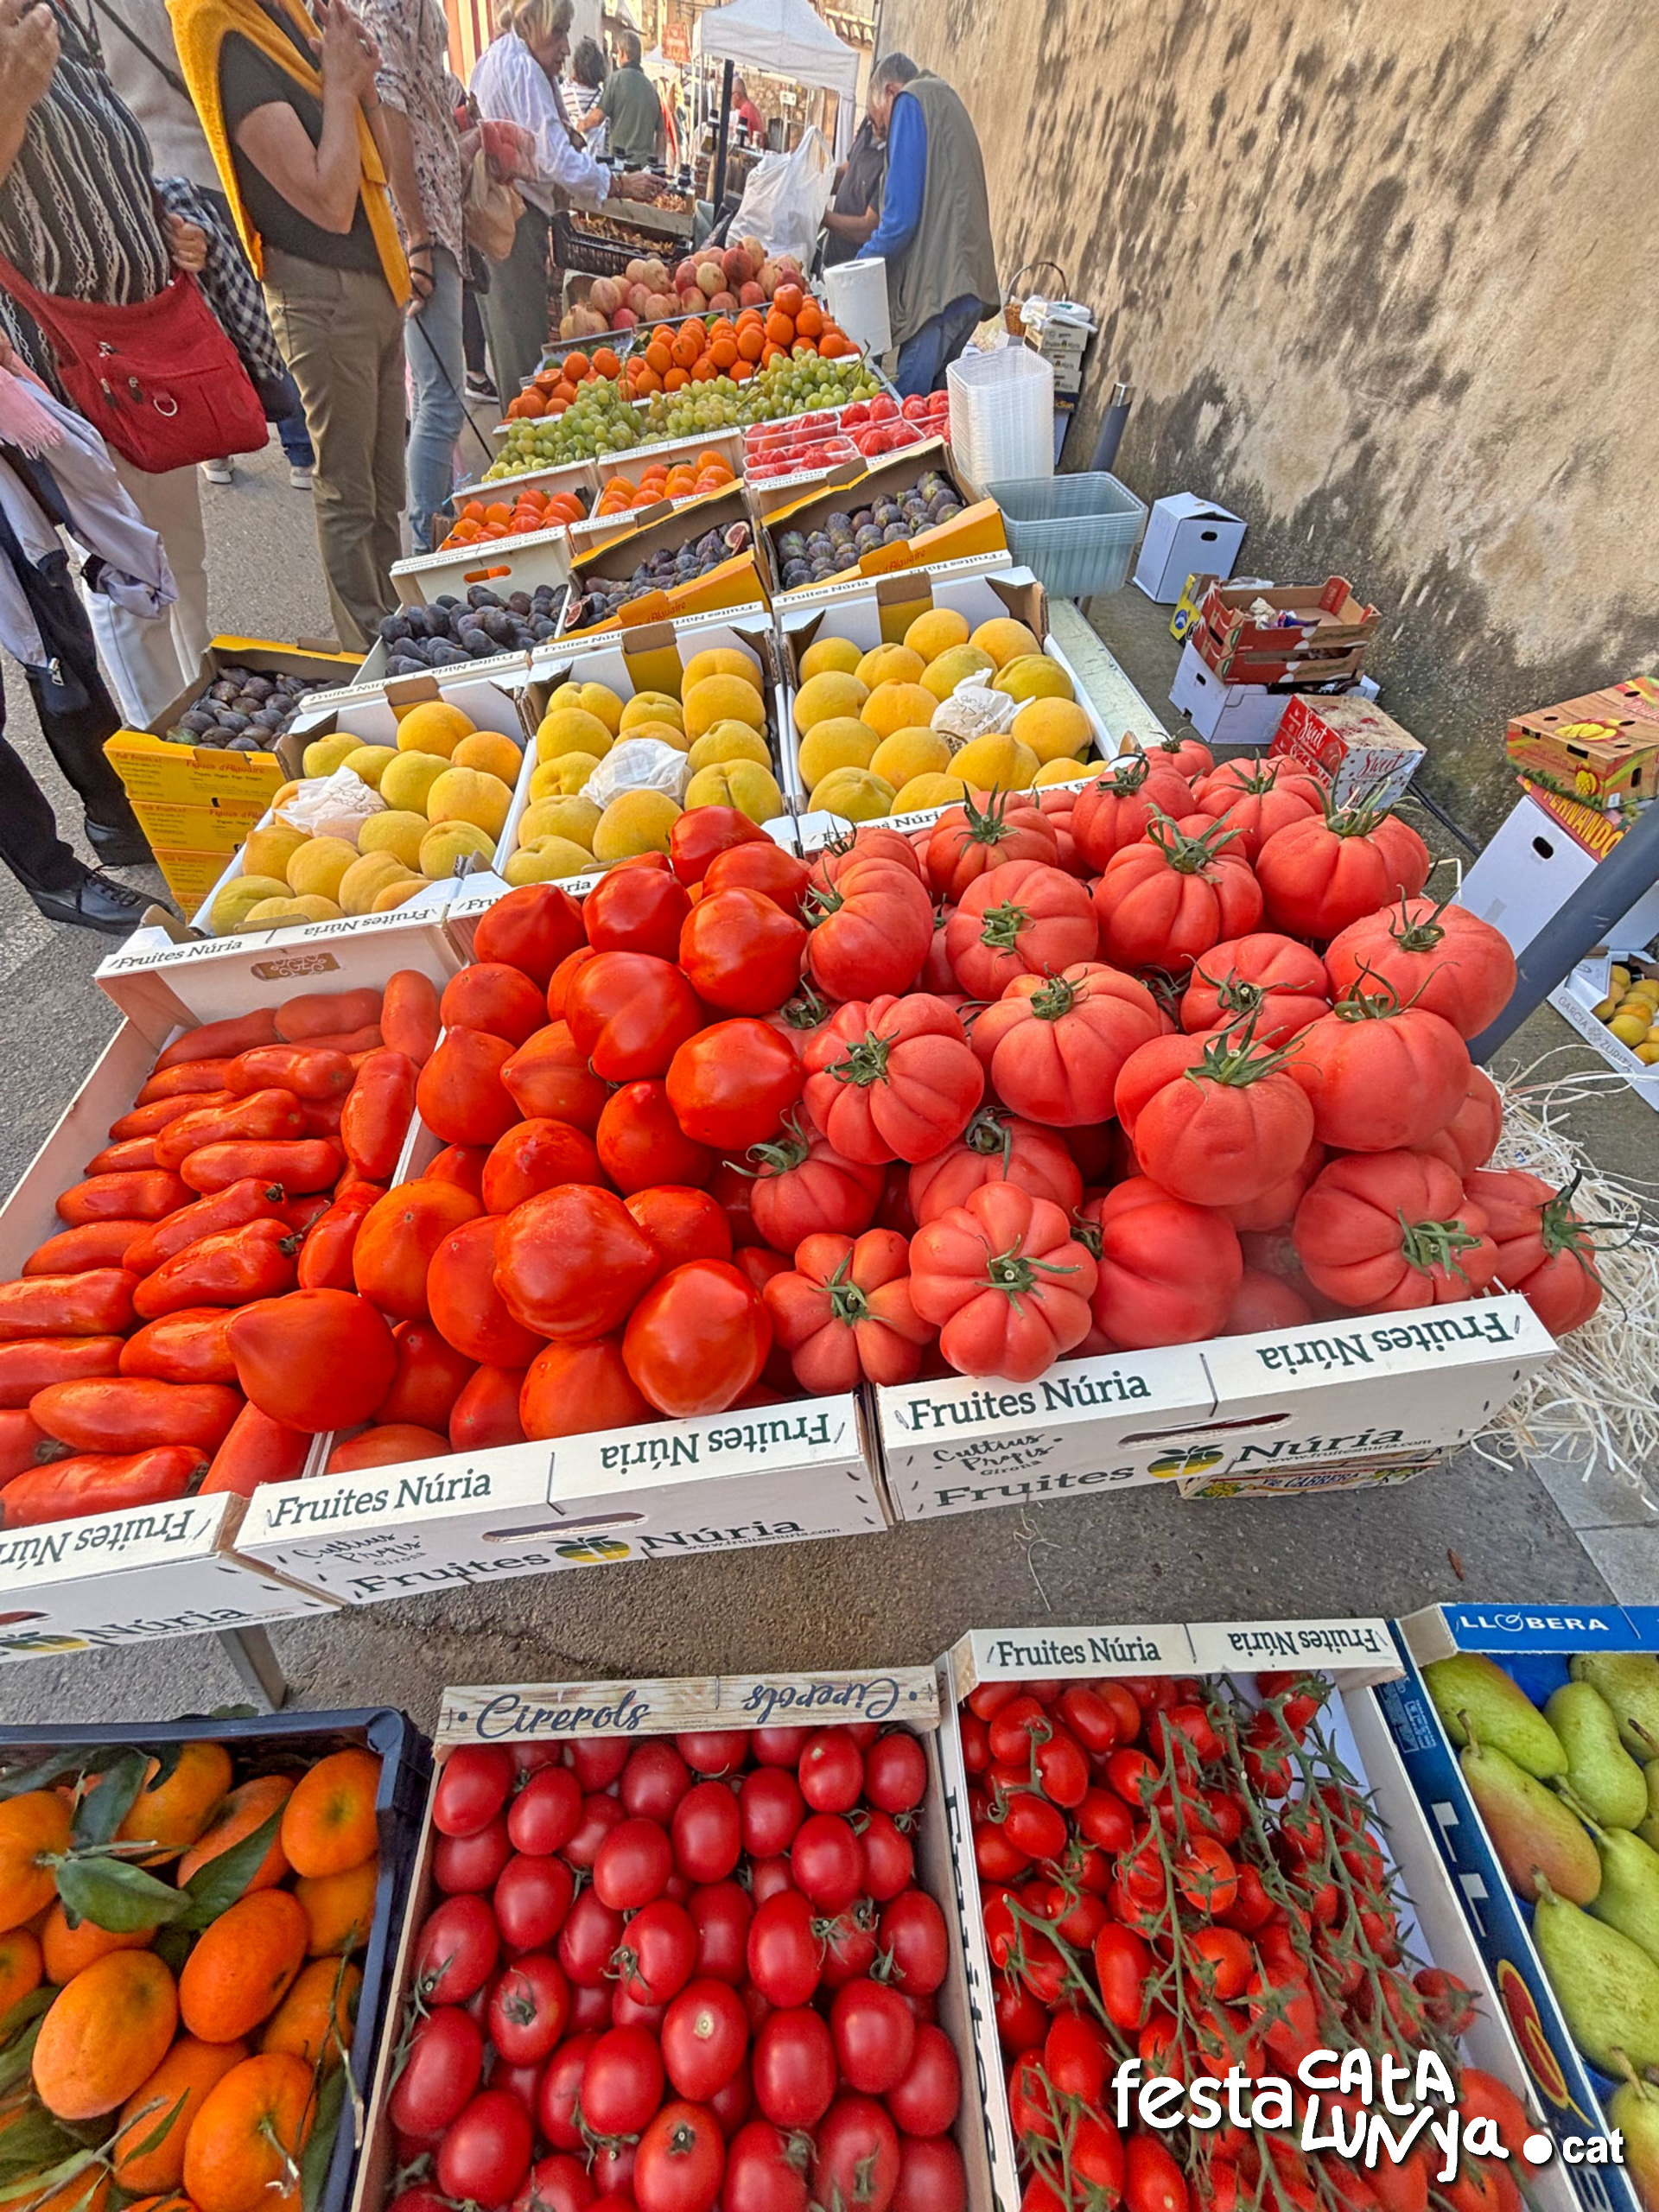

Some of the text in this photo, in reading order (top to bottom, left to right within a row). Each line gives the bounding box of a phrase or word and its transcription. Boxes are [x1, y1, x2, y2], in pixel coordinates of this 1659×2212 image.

[591, 632, 622, 645] Núri
[303, 908, 431, 937] Fruites Núria
[116, 938, 243, 970] Fruites Núria
[1255, 1312, 1514, 1376] Fruites Núria
[908, 1370, 1151, 1431] Fruites Núria
[600, 1413, 831, 1475] Fruites Núria
[1236, 1428, 1405, 1463] Núria
[270, 1468, 492, 1528] Fruites Núria
[934, 1465, 1135, 1508] Fruites
[74, 1509, 196, 1552] Fruites
[635, 1519, 805, 1551] Núria
[346, 1552, 551, 1594] Fruites
[72, 1606, 255, 1637] Núria
[1459, 1610, 1611, 1634] LLOBERA
[998, 1636, 1161, 1668] Fruites Núria
[1229, 1627, 1380, 1657] Fruites Núria
[477, 1689, 652, 1740] Cirerols
[741, 1677, 899, 1722] Cirerols
